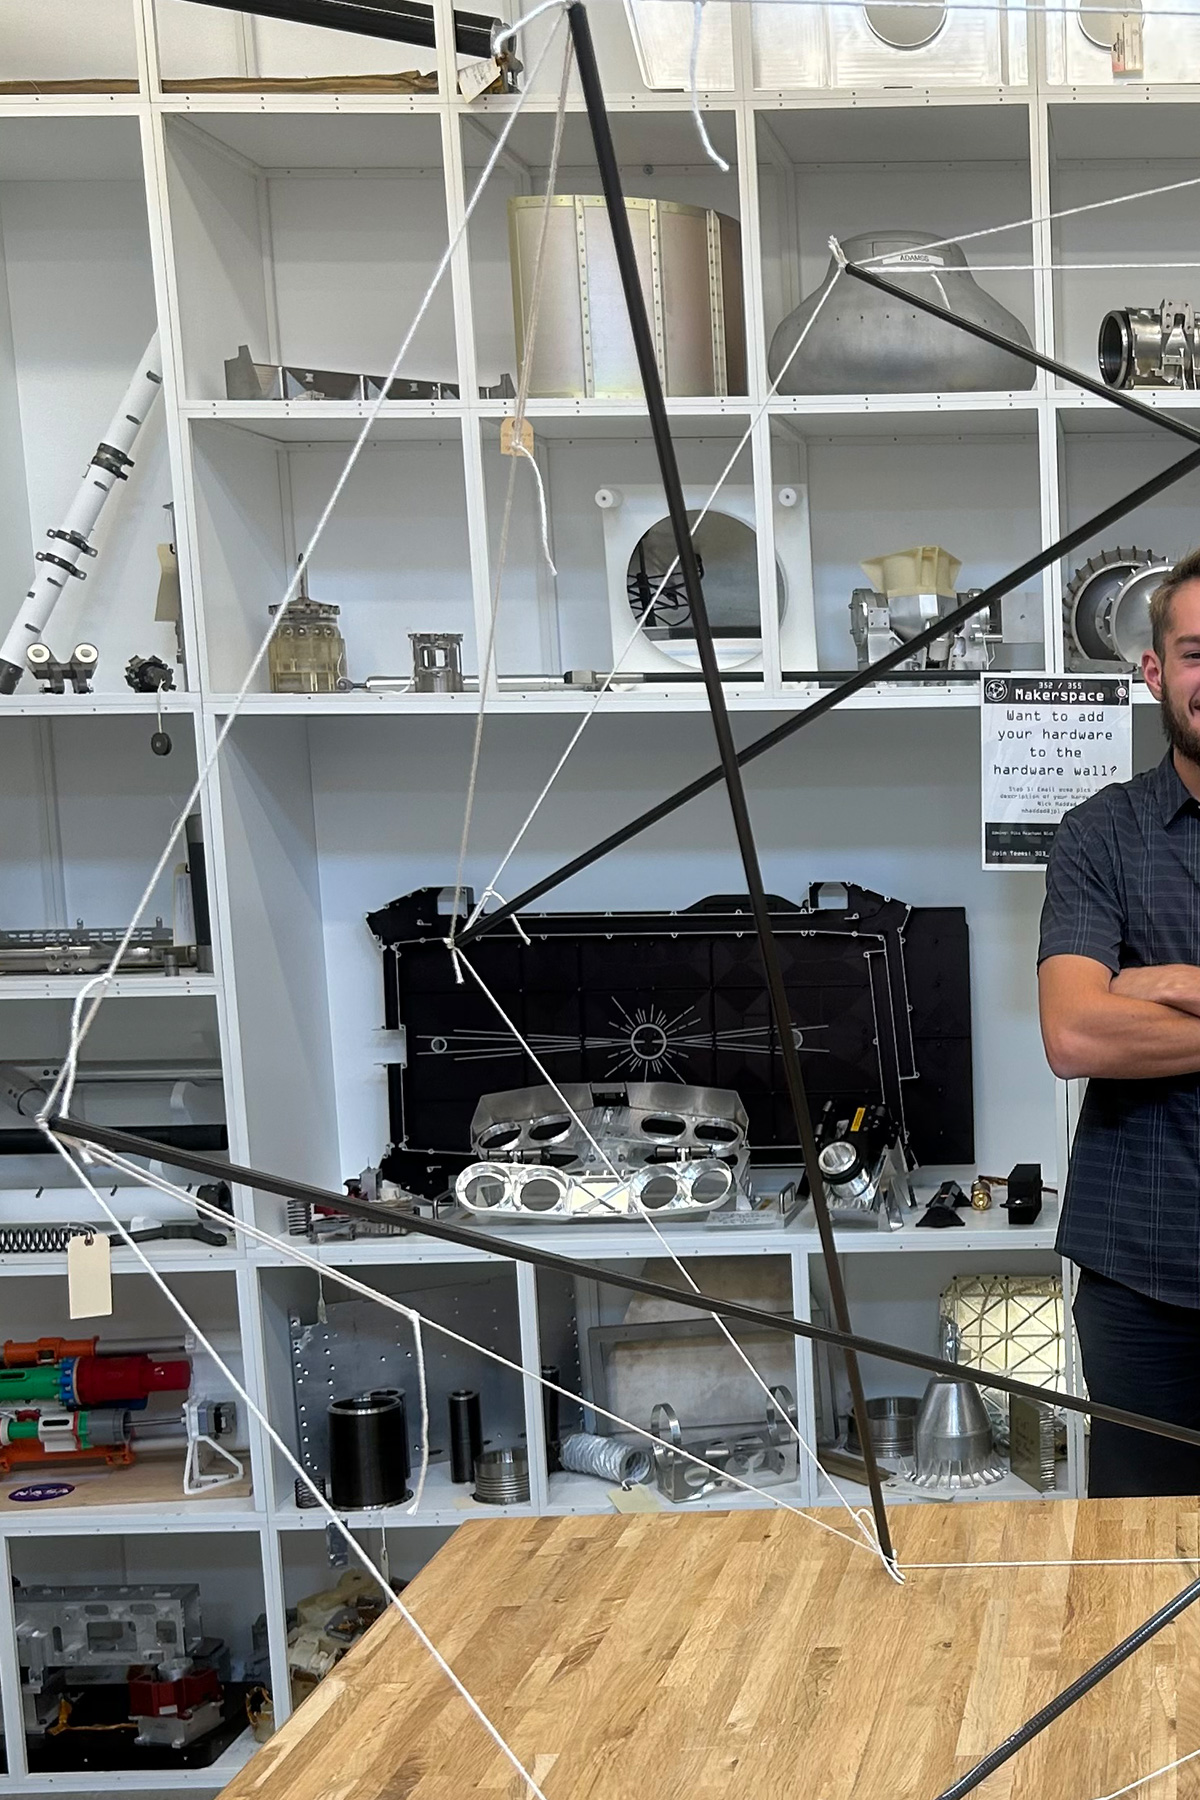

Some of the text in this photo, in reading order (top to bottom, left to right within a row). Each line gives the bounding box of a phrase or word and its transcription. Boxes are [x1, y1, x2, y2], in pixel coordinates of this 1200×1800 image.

[1038, 681, 1053, 689] 352
[1067, 682, 1082, 690] 355
[1015, 688, 1105, 703] Makerspace
[1006, 710, 1104, 722] Want to add
[998, 729, 1113, 741] your hardware
[1030, 747, 1082, 758] to the
[993, 764, 1118, 777] hardware wall?
[1076, 786, 1091, 794] pics
